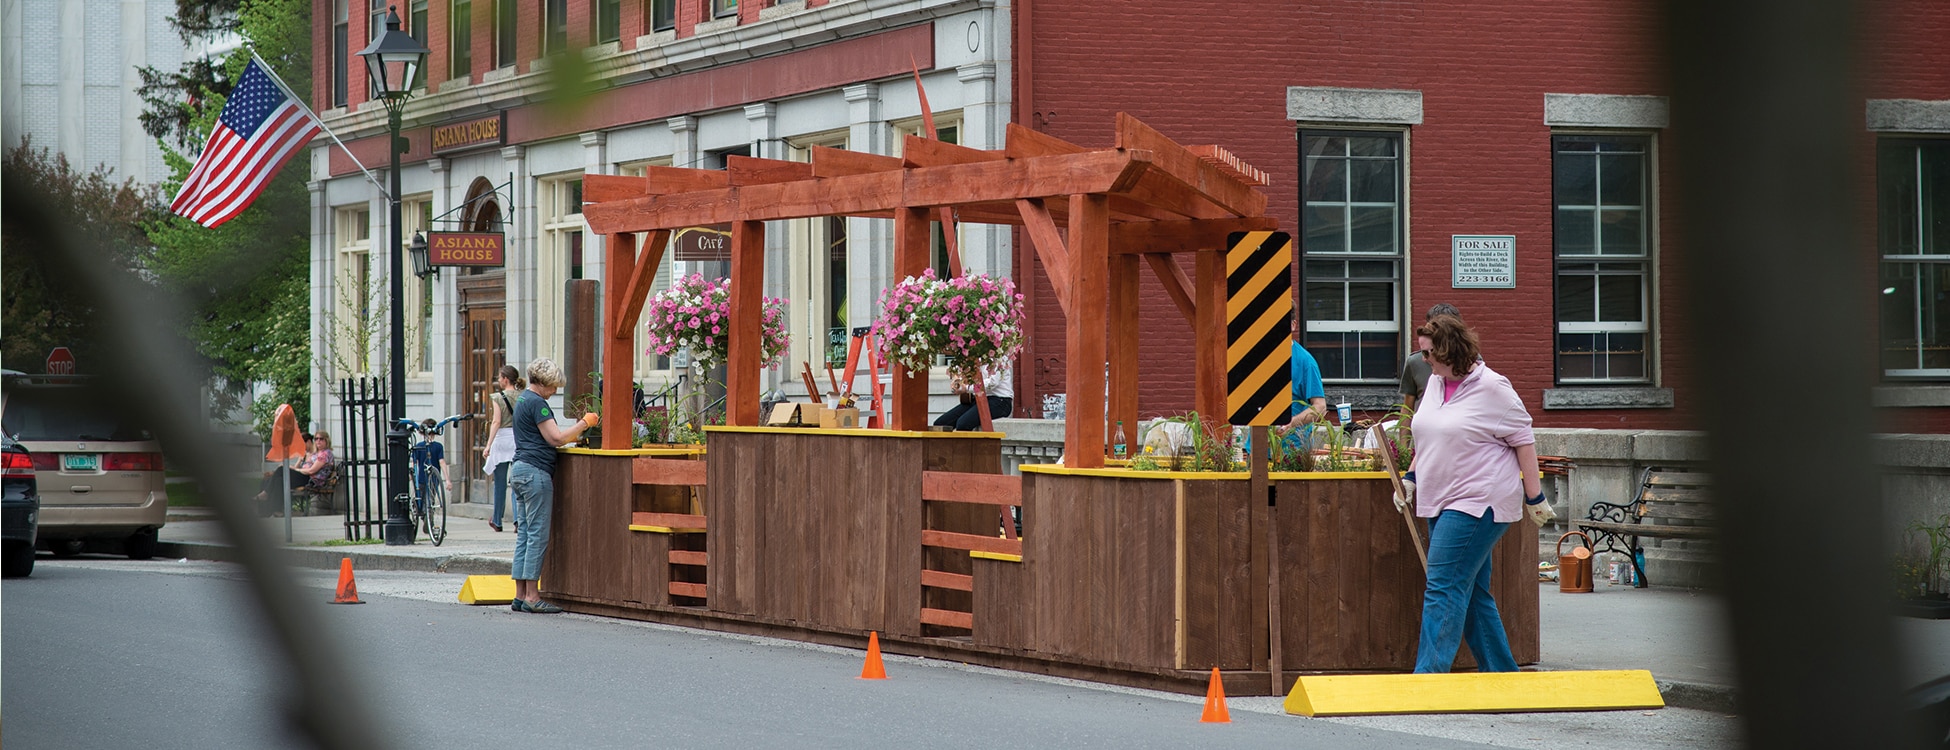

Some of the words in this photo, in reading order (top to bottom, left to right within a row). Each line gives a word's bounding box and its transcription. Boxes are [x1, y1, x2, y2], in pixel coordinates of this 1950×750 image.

[434, 124, 467, 148] ASIANA
[469, 119, 498, 141] HOUSE
[434, 237, 498, 248] ASIANA
[1459, 241, 1480, 249] FOR
[1483, 241, 1509, 249] SALE
[440, 249, 494, 261] HOUSE
[49, 361, 73, 375] STOP
